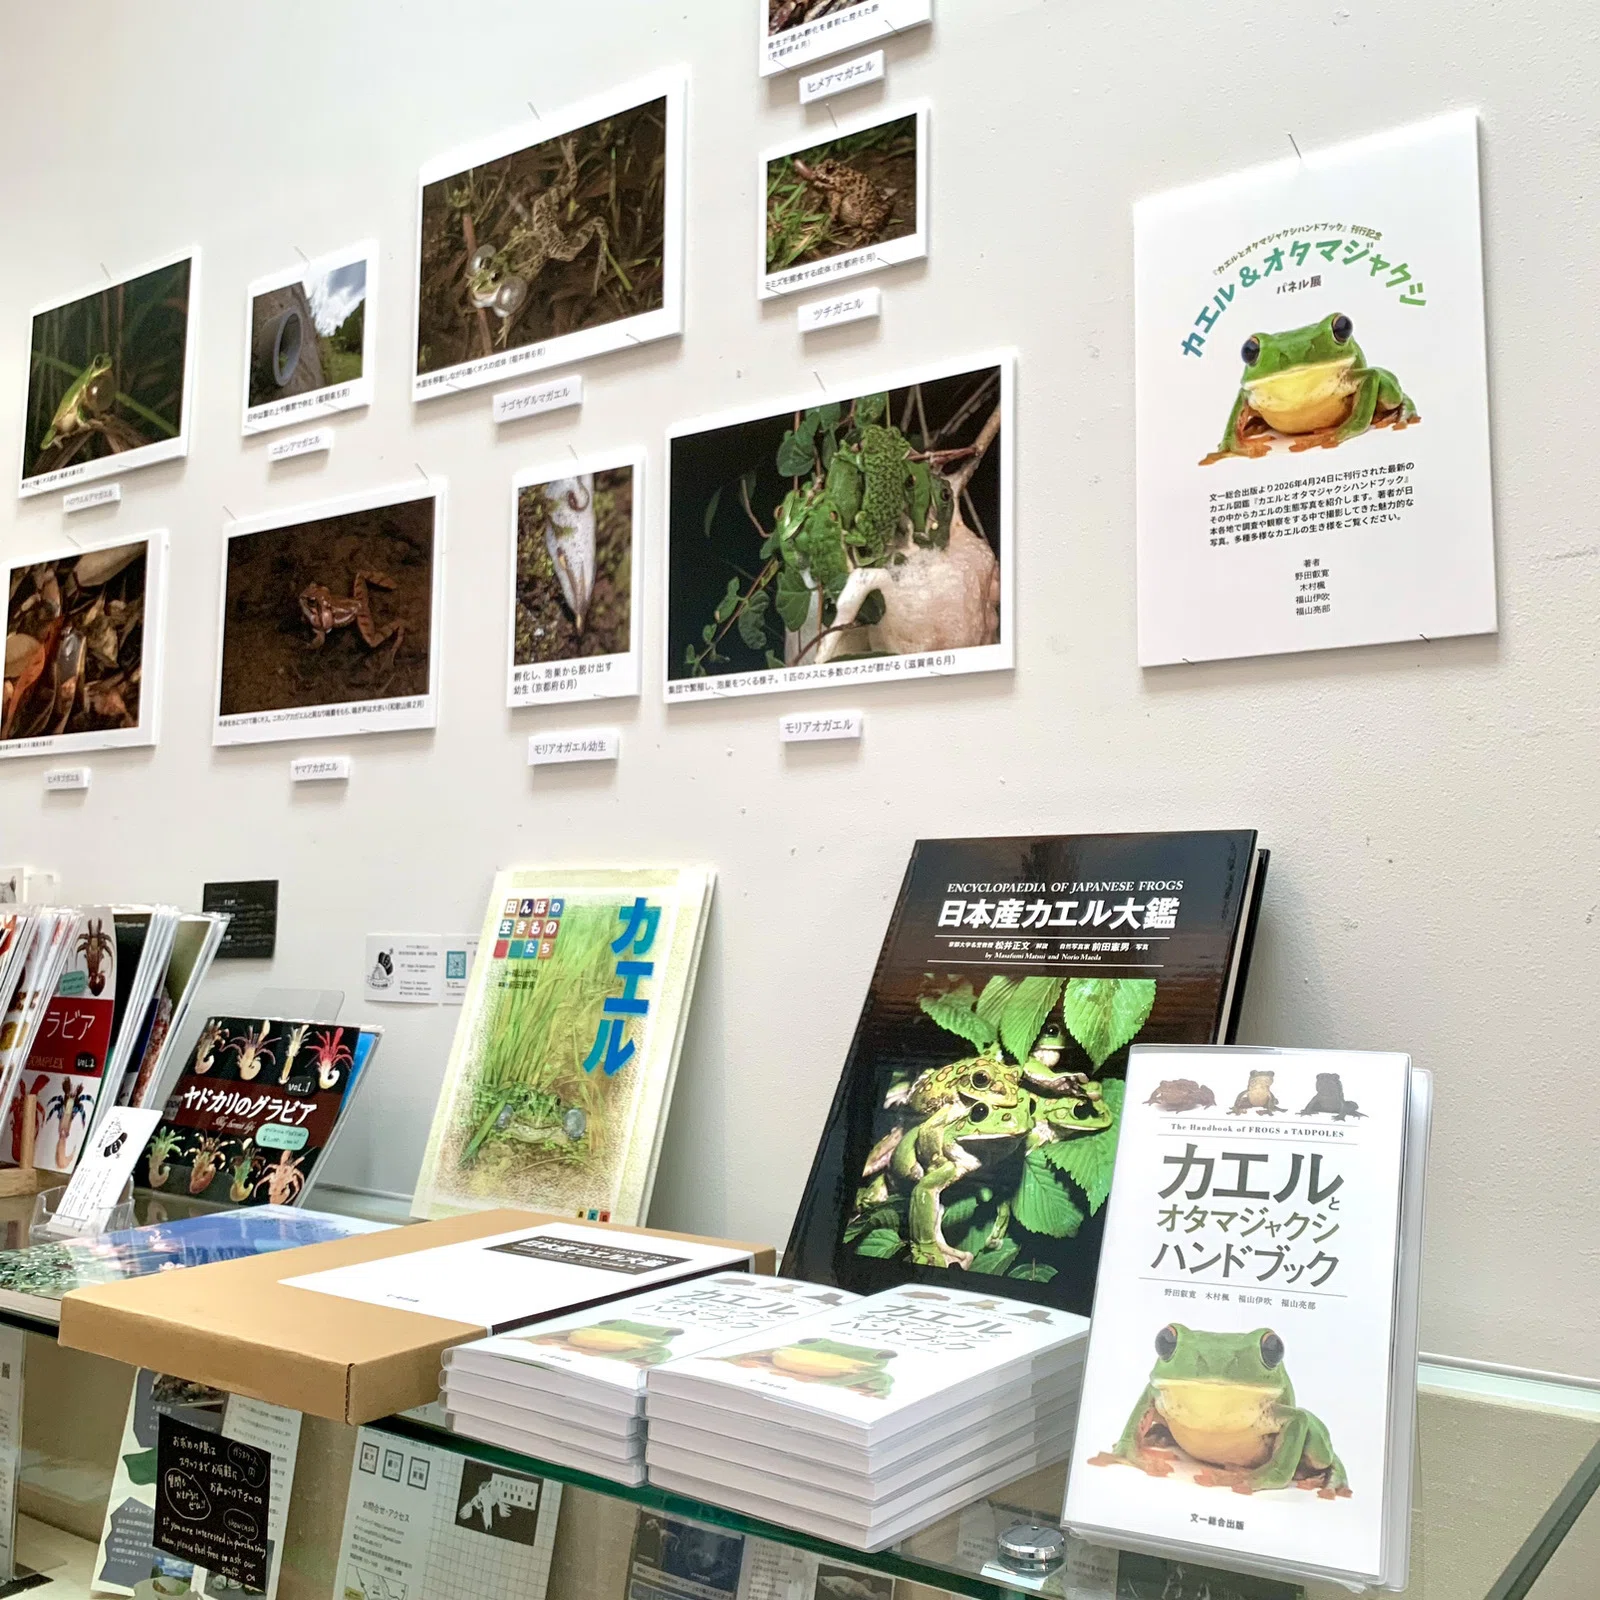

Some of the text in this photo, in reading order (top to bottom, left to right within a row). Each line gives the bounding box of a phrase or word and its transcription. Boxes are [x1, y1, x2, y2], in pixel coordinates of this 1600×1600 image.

[807, 60, 875, 93] ヒメアマガエル
[1276, 275, 1322, 294] パネル展
[813, 298, 864, 321] ツチガエル
[501, 387, 570, 412] ナゴヤダルマガエル
[1303, 558, 1320, 568] 著者
[1296, 593, 1331, 604] 福山伊吹
[785, 718, 854, 734] モリアオガエル
[534, 740, 606, 755] モリアオガエル幼生
[295, 763, 339, 774] ヤマアカガエル
[947, 880, 1184, 893] ENCYCLOPAEDIA OF JAPANESE FROGS
[938, 897, 1181, 930] 日本産カエル大鑑
[500, 920, 557, 936] 生きもの
[525, 942, 551, 954] たち
[582, 897, 662, 1077] カエル
[183, 1086, 317, 1126] ヤドカリのグラビア
[1171, 1123, 1186, 1131] The
[1190, 1124, 1233, 1132] Handbook
[1248, 1126, 1281, 1135] FROGS
[1291, 1128, 1345, 1138] TADPOLES
[1157, 1204, 1340, 1244] オタマジャクシ
[1151, 1242, 1340, 1287] ハンドブック
[1238, 1294, 1273, 1306] 福山伊吹
[1190, 1513, 1244, 1530] 文一総合出版
